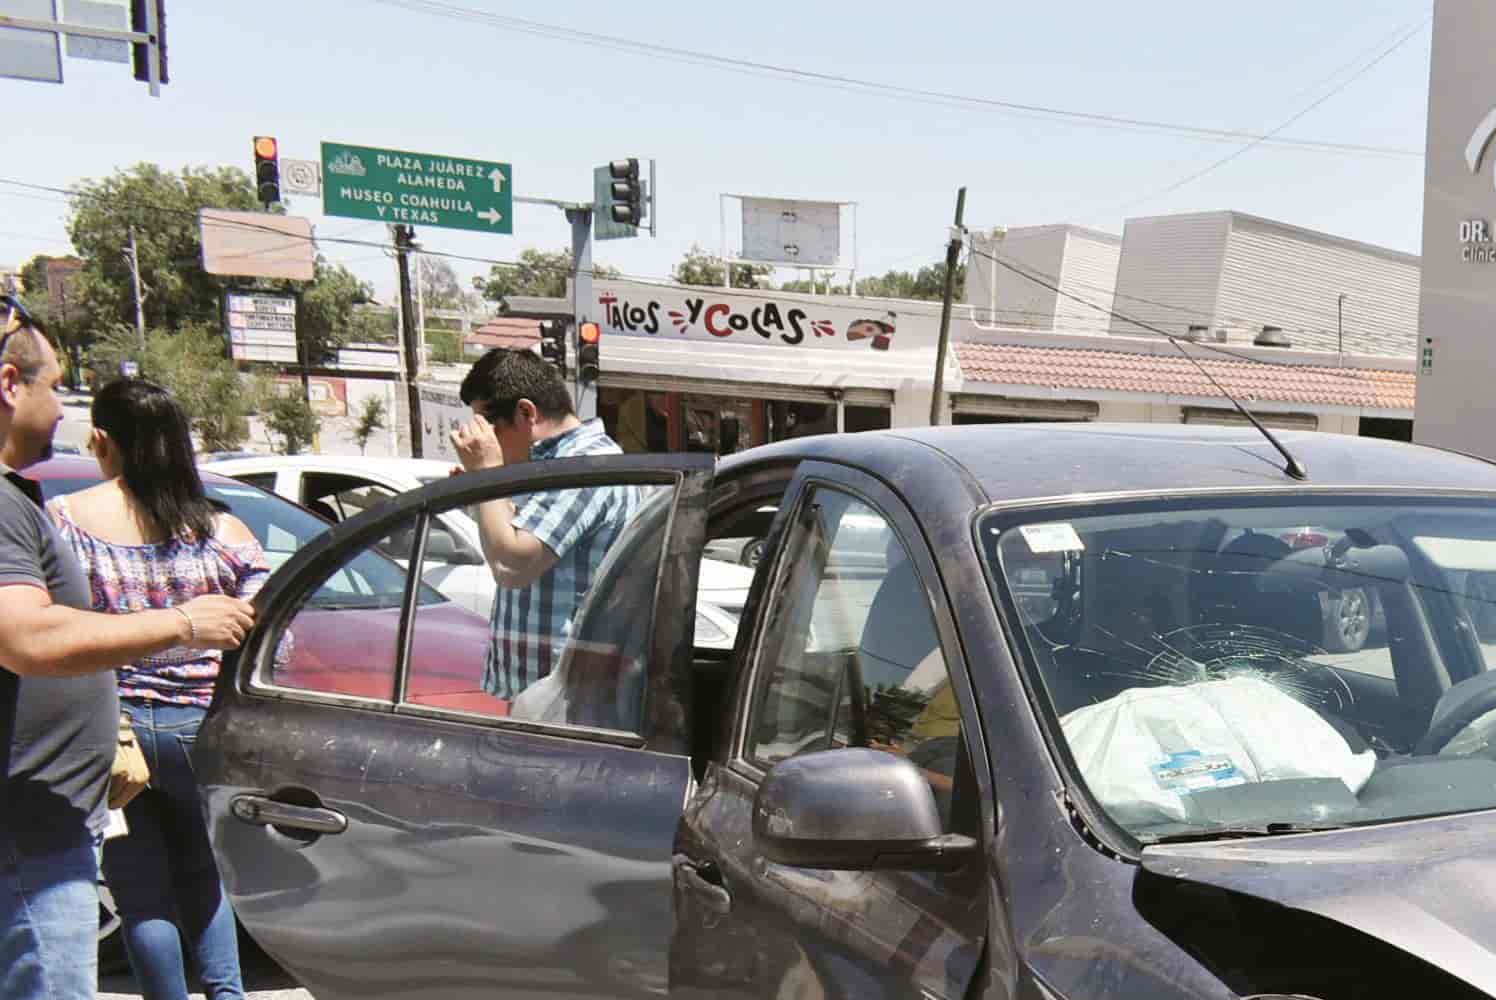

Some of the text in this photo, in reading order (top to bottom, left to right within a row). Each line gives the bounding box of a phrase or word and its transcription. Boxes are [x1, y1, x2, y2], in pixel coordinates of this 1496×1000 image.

[377, 154, 484, 178] PLAZA JUÁREZ
[398, 173, 465, 192] ALAMEDA
[340, 187, 473, 212] MUSEO COAHUILA
[376, 206, 439, 223] Y TEXAS
[1460, 220, 1489, 242] DR.
[599, 294, 806, 345] TACOS Y COCAS
